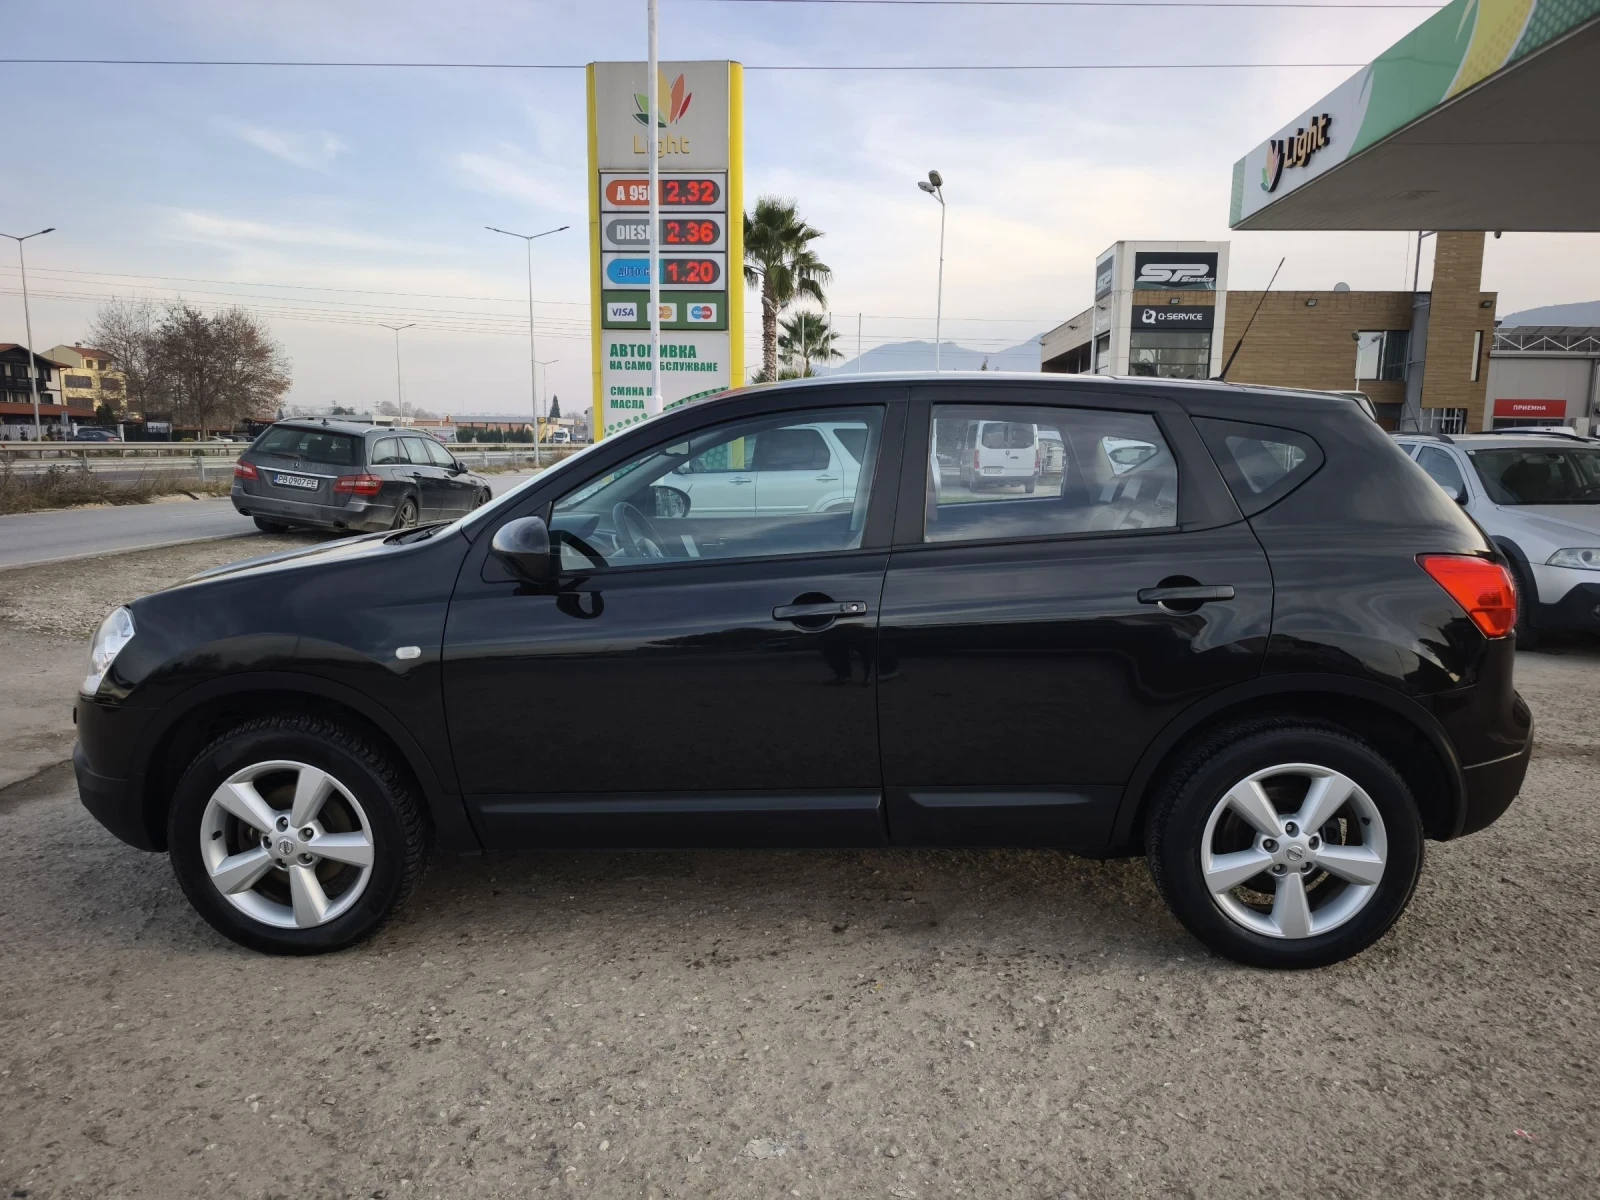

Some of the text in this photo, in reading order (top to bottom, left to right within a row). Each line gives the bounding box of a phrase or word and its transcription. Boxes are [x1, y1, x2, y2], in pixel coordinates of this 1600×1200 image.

[1284, 113, 1332, 168] Light
[616, 185, 626, 201] A
[666, 181, 714, 204] 2.32
[616, 222, 714, 243] DIES 2.36
[617, 265, 641, 278] AUTO
[667, 261, 714, 282] 1.20
[1180, 275, 1215, 283] Service
[611, 307, 635, 317] VISA
[609, 360, 718, 372] НА САМОБСЛУЖВАНЕ
[610, 386, 645, 397] СМЯНА
[610, 399, 645, 410] МАСЛА
